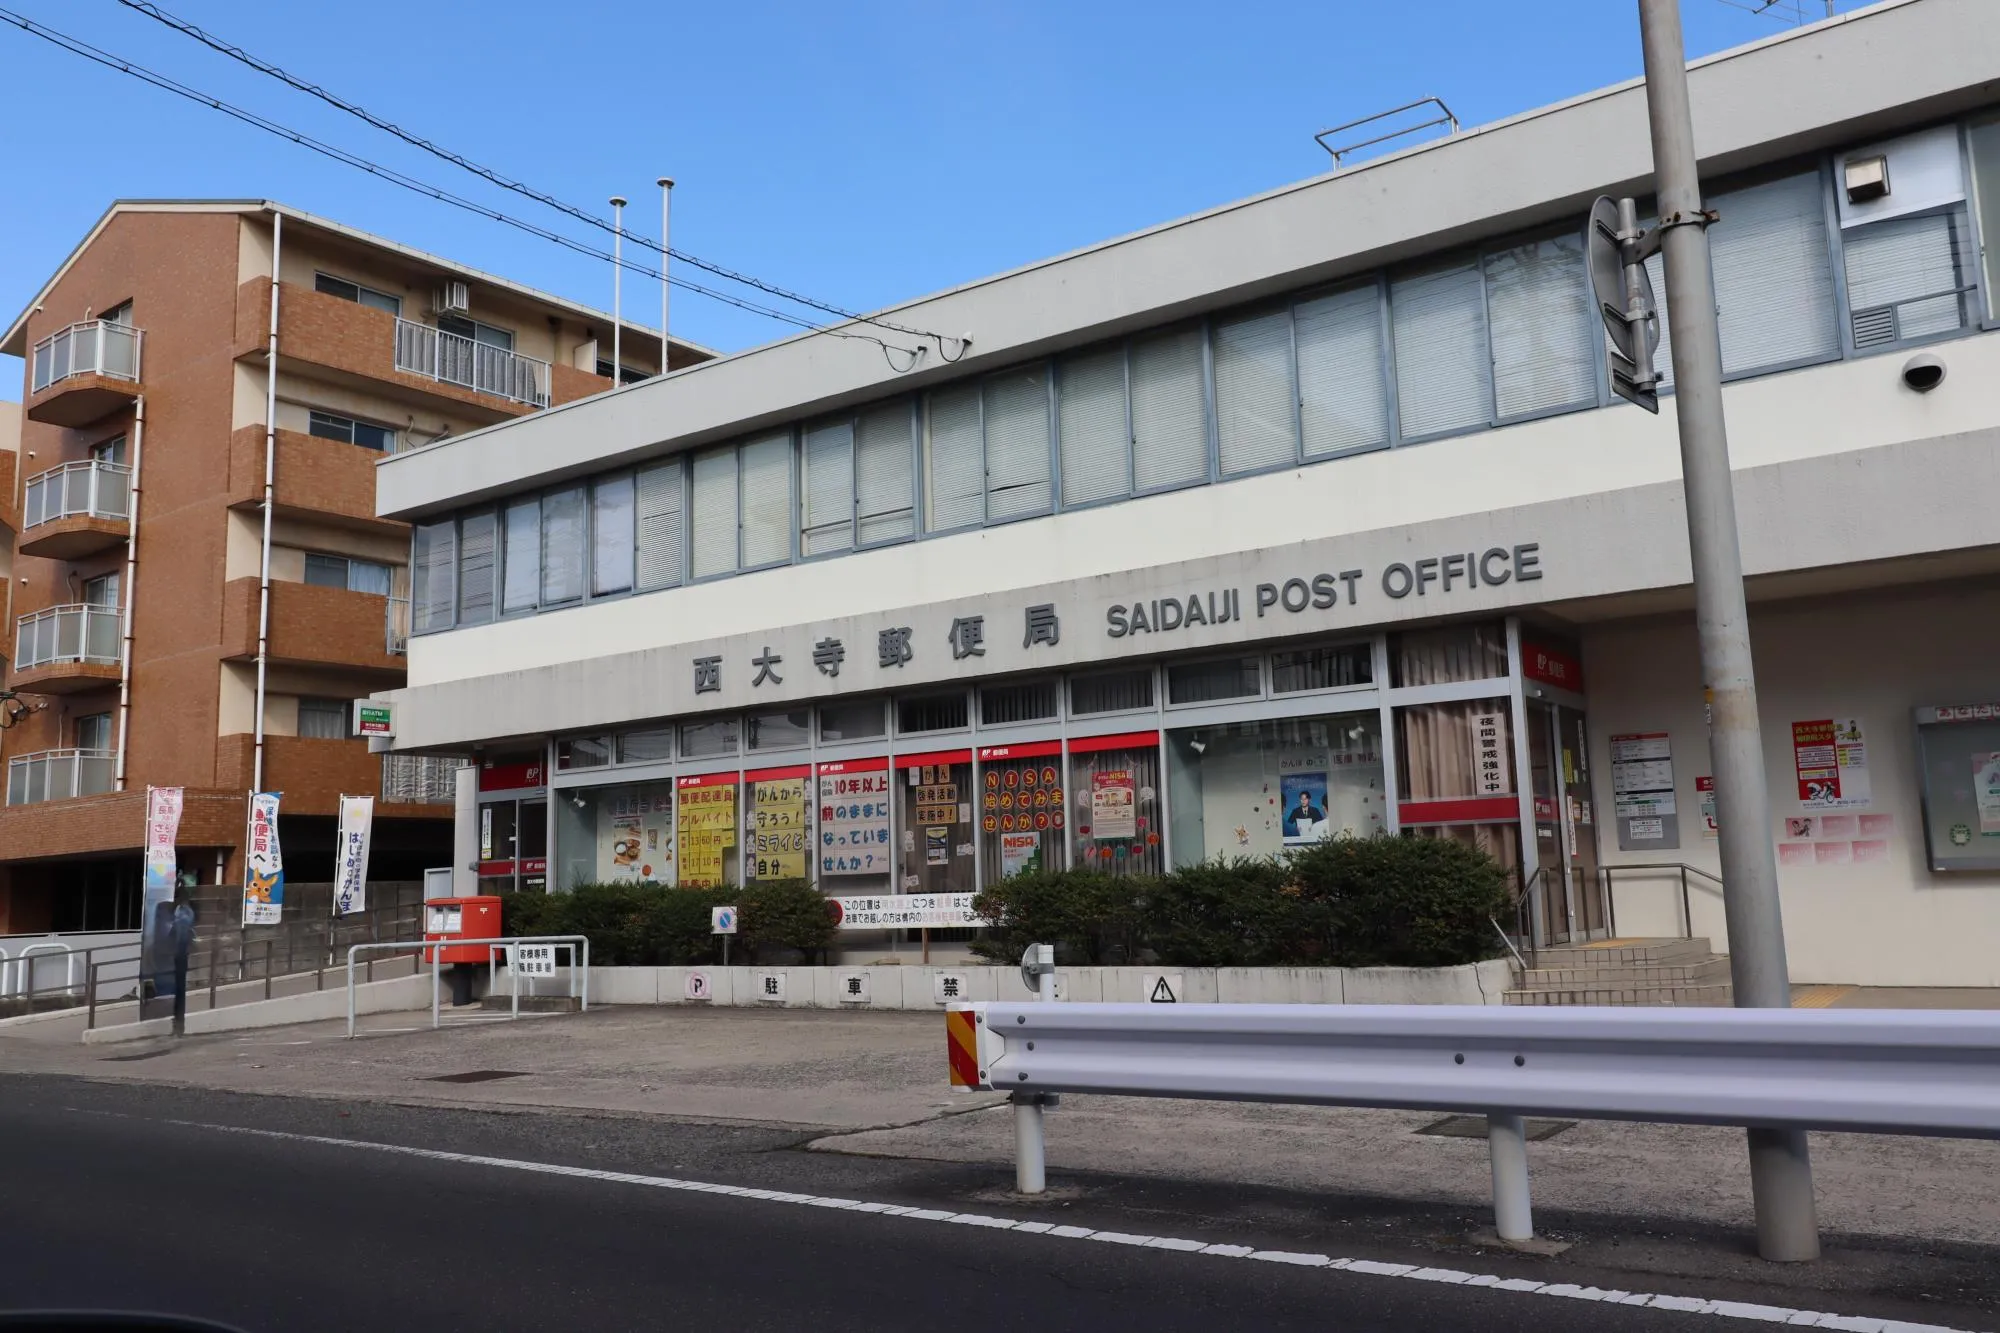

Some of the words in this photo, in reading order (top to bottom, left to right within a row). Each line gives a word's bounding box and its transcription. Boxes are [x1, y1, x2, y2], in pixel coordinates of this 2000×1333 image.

[1107, 588, 1240, 638] SAIDAIJI
[1257, 569, 1362, 617] POST
[1382, 542, 1543, 599] OFFICE
[693, 603, 1060, 695] 西大寺郵便局
[1480, 717, 1500, 792] 夜間警戒強化中
[924, 768, 947, 781] がん
[987, 771, 1054, 786] NISA
[834, 776, 888, 794] 10年以上
[680, 789, 733, 805] 郵便配達員
[757, 786, 802, 802] がんから
[984, 790, 1062, 807] 始めてみま
[680, 812, 732, 825] アルバイト
[757, 811, 800, 828] 守ろう！
[821, 803, 888, 821] 前のままに
[757, 833, 802, 852] ミライと
[823, 829, 888, 846] なっていま
[1003, 837, 1034, 848] NISA
[758, 859, 780, 875] 自分
[823, 854, 873, 871] せんか？
[520, 948, 548, 959] 客様専用
[765, 977, 778, 995] 駐
[848, 978, 862, 995] 車
[943, 978, 959, 996] 禁
